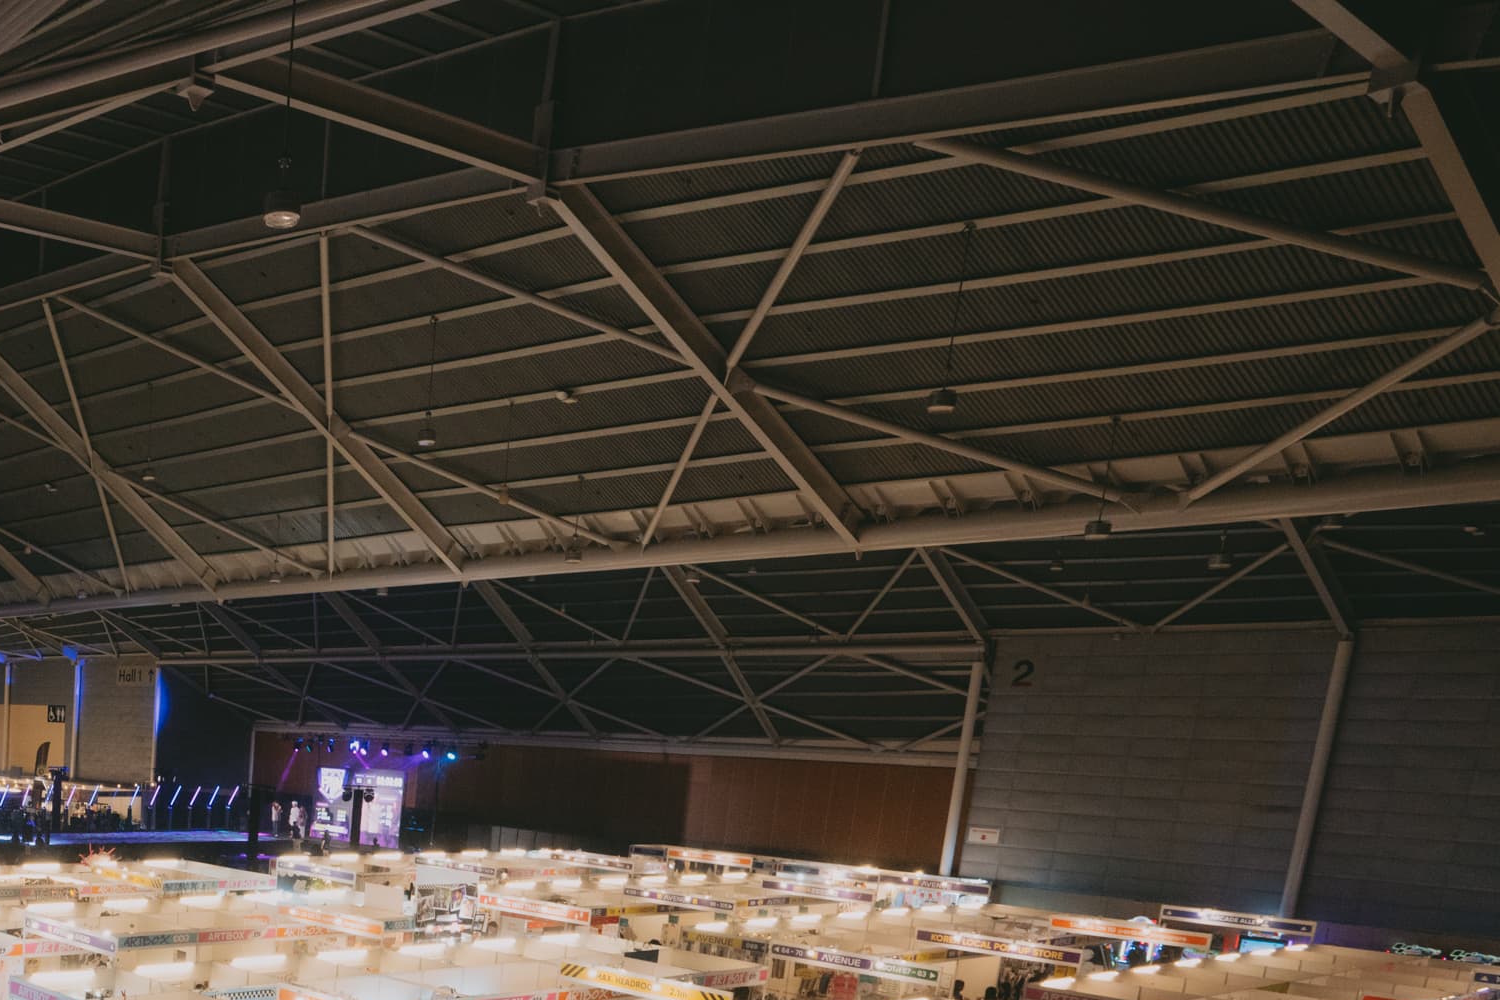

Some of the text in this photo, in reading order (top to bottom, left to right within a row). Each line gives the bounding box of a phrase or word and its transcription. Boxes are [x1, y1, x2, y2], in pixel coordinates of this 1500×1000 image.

[118, 669, 136, 683] Hall
[1012, 660, 1036, 687] 2
[209, 930, 245, 941] ARTBOX
[962, 938, 1064, 960] LOCAL STORE
[821, 954, 861, 968] AVENUE
